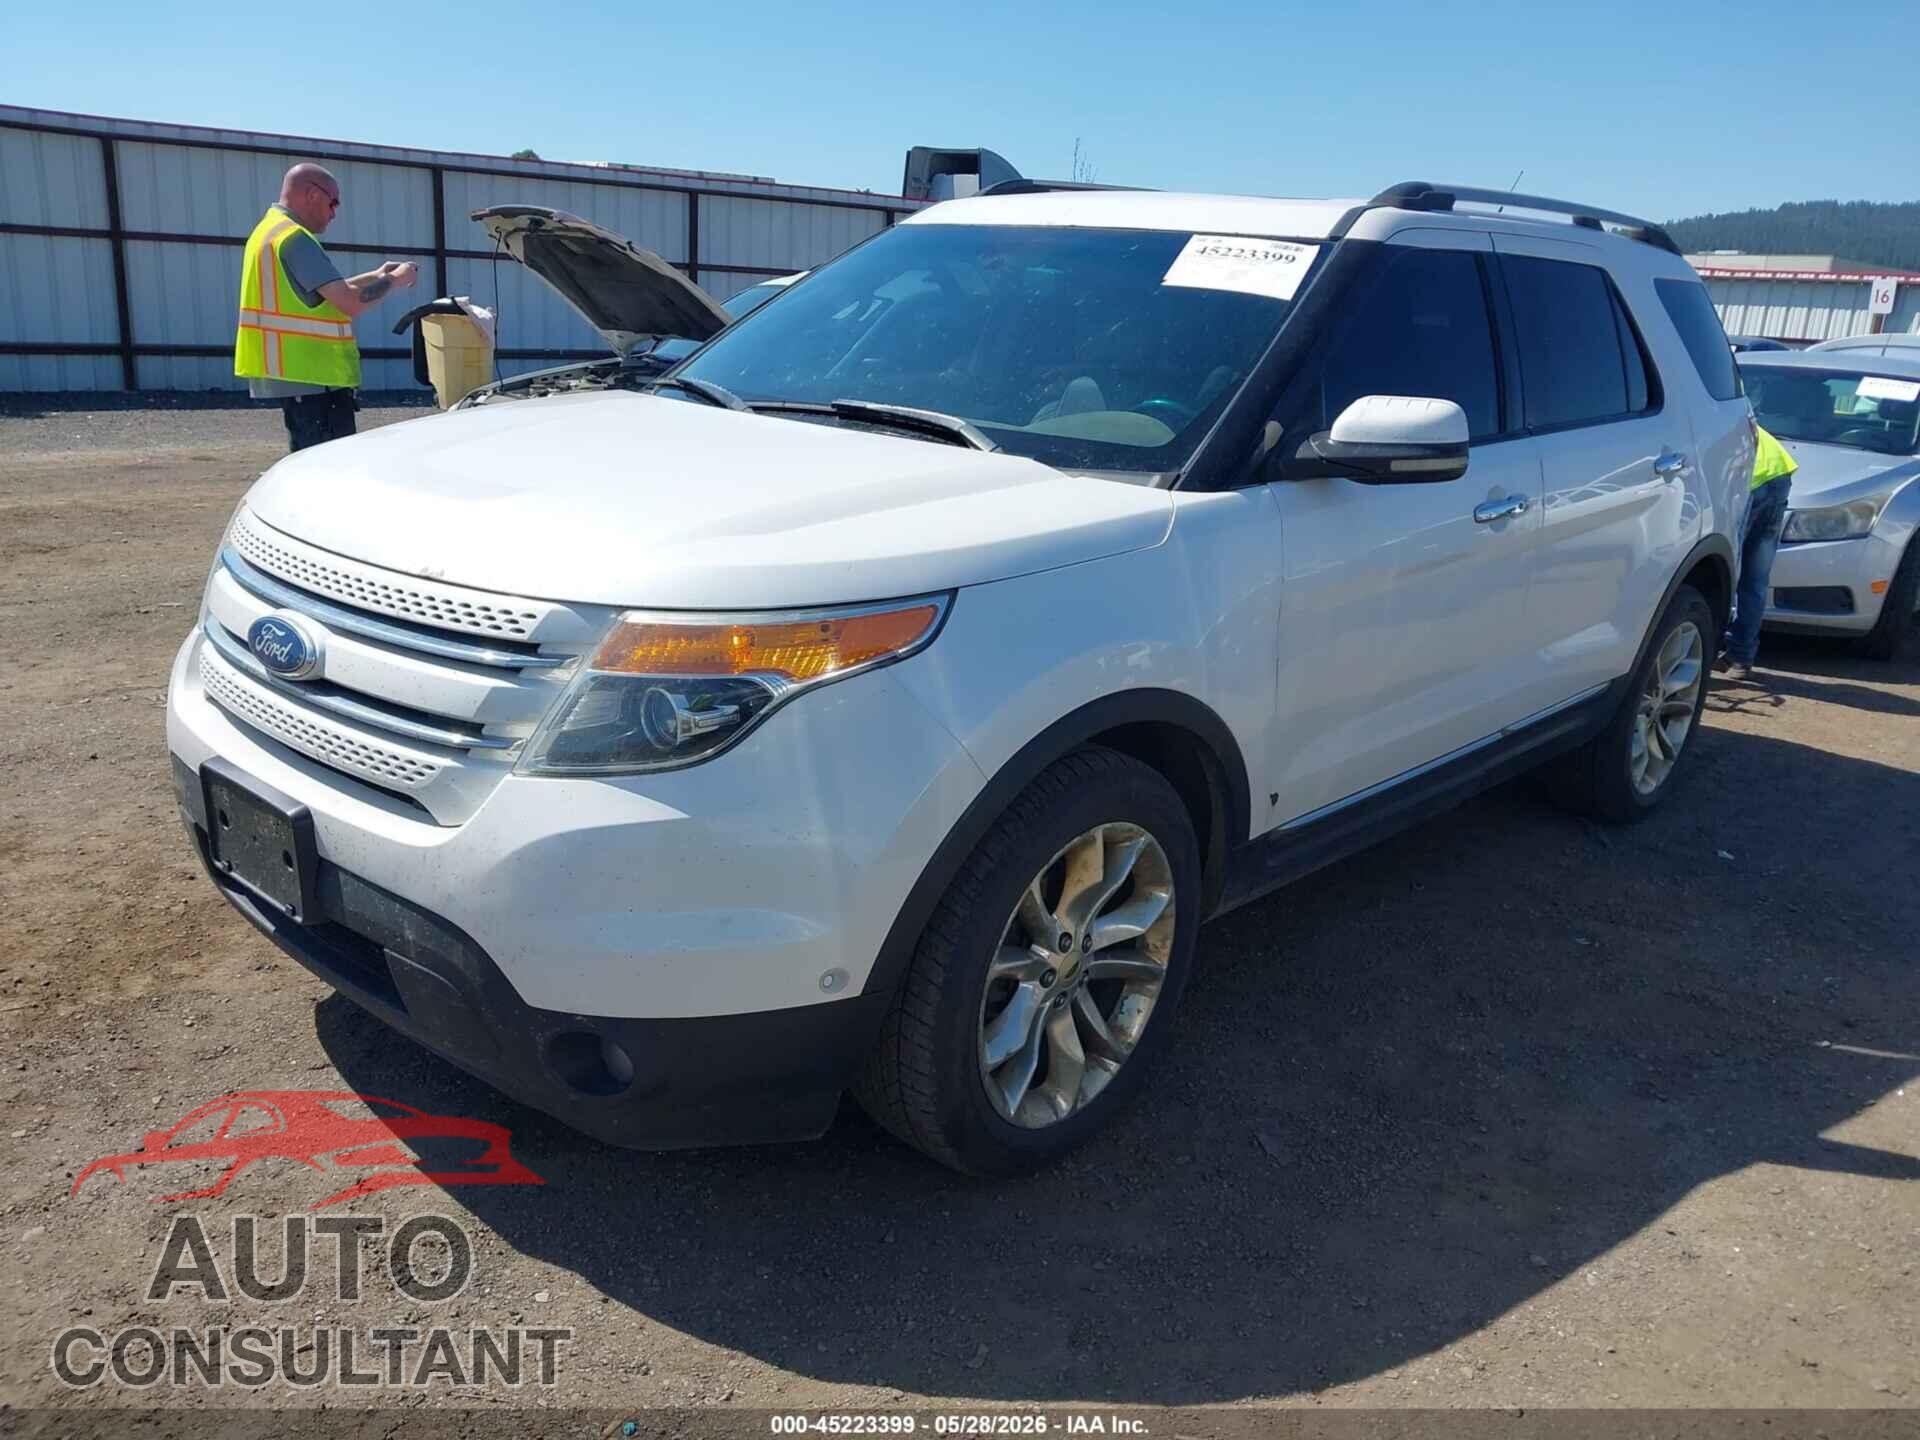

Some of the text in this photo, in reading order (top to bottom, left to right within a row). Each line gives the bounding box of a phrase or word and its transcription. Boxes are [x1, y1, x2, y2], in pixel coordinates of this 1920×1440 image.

[1195, 245, 1297, 264] 45223399
[1874, 289, 1890, 304] 16
[255, 623, 293, 663] Ford
